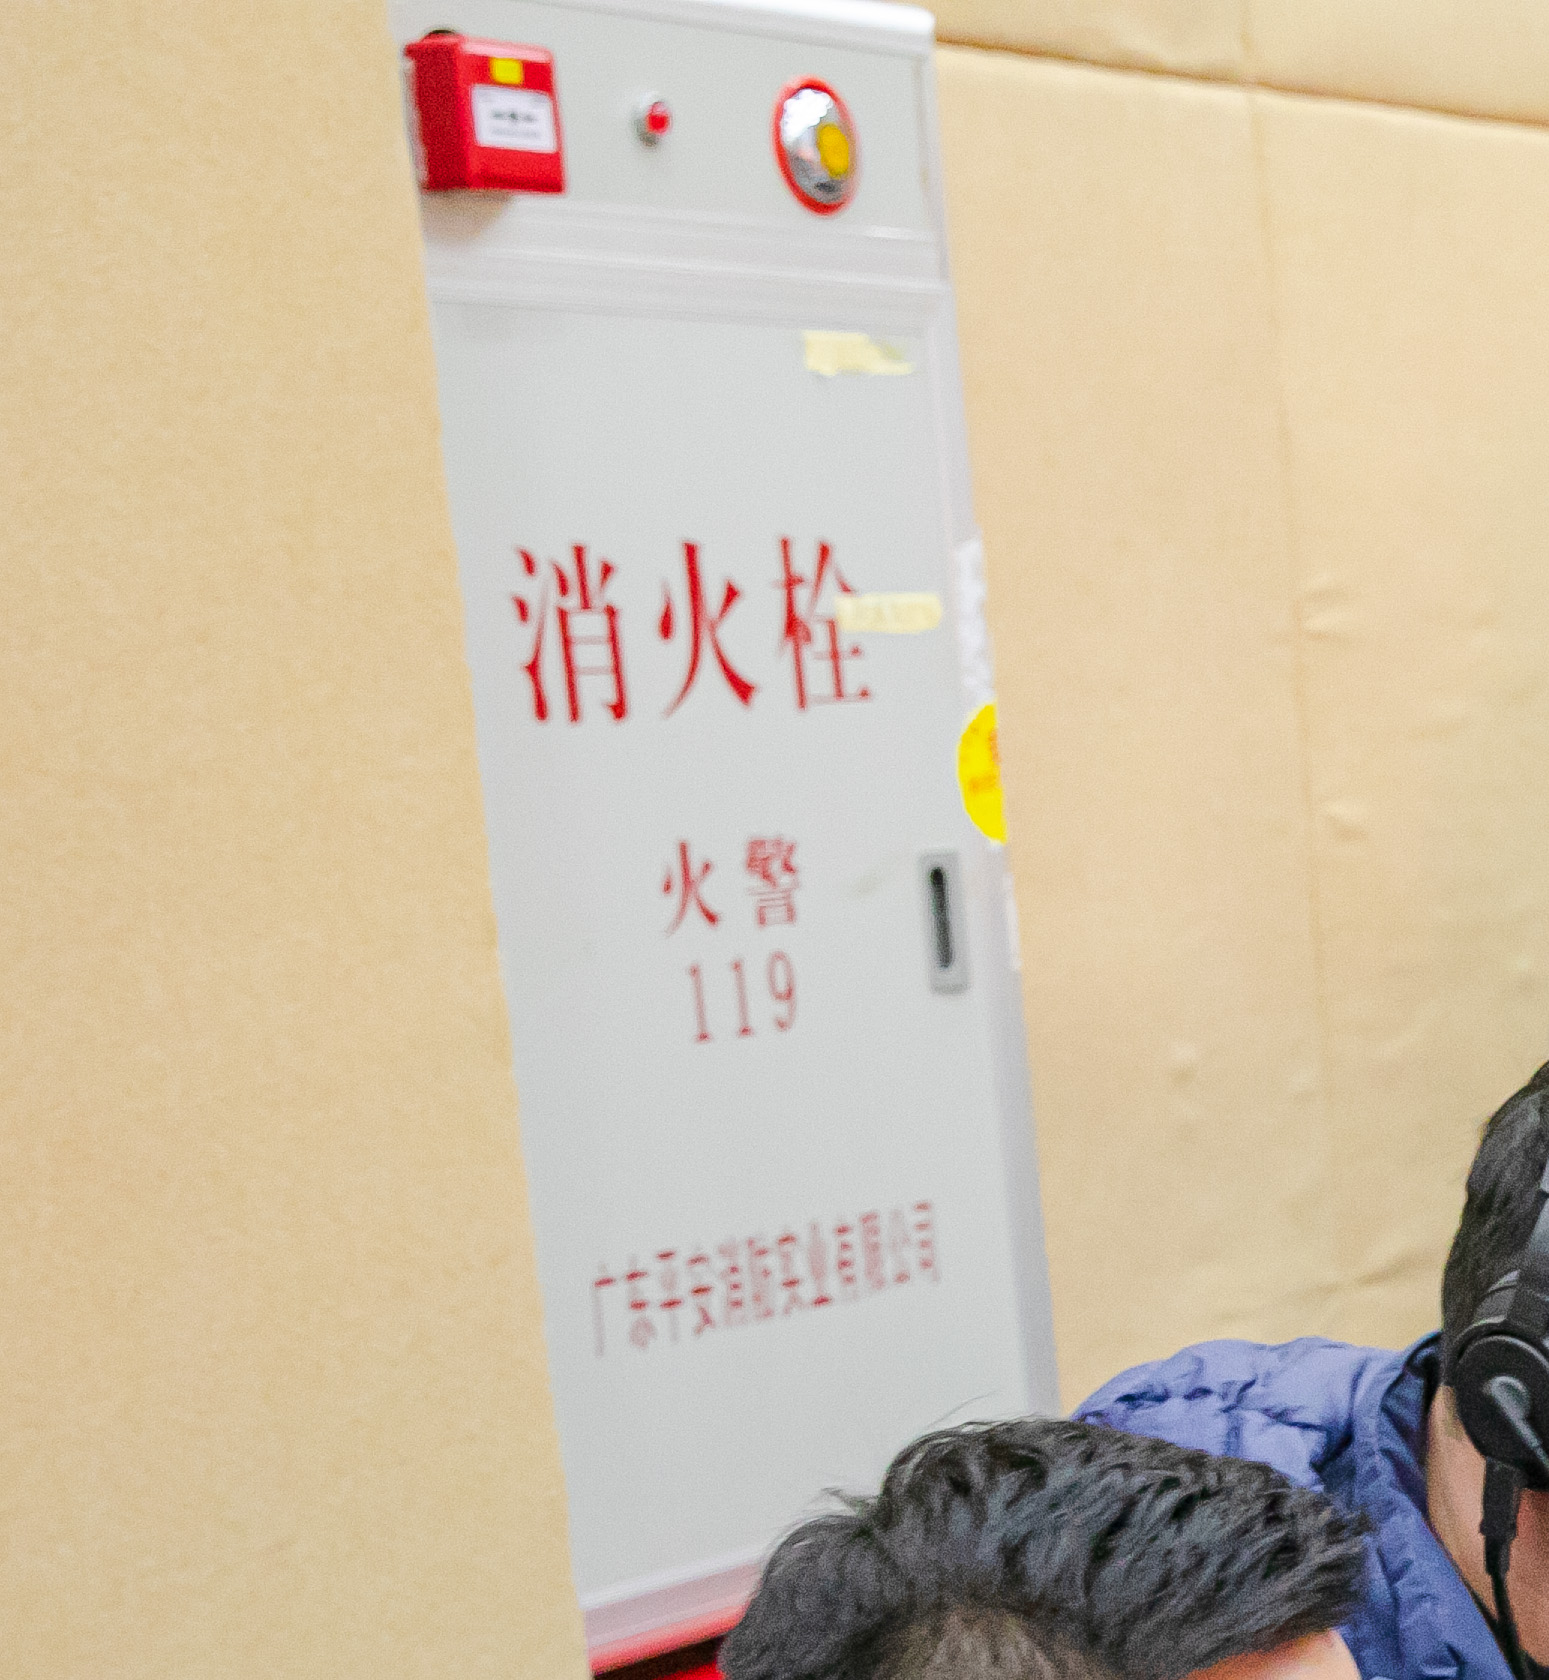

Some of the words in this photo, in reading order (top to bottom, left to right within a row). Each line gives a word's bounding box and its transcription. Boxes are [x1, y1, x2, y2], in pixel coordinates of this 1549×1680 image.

[510, 536, 873, 724] 消火栓
[662, 836, 800, 937] 火警
[687, 951, 798, 1044] 119
